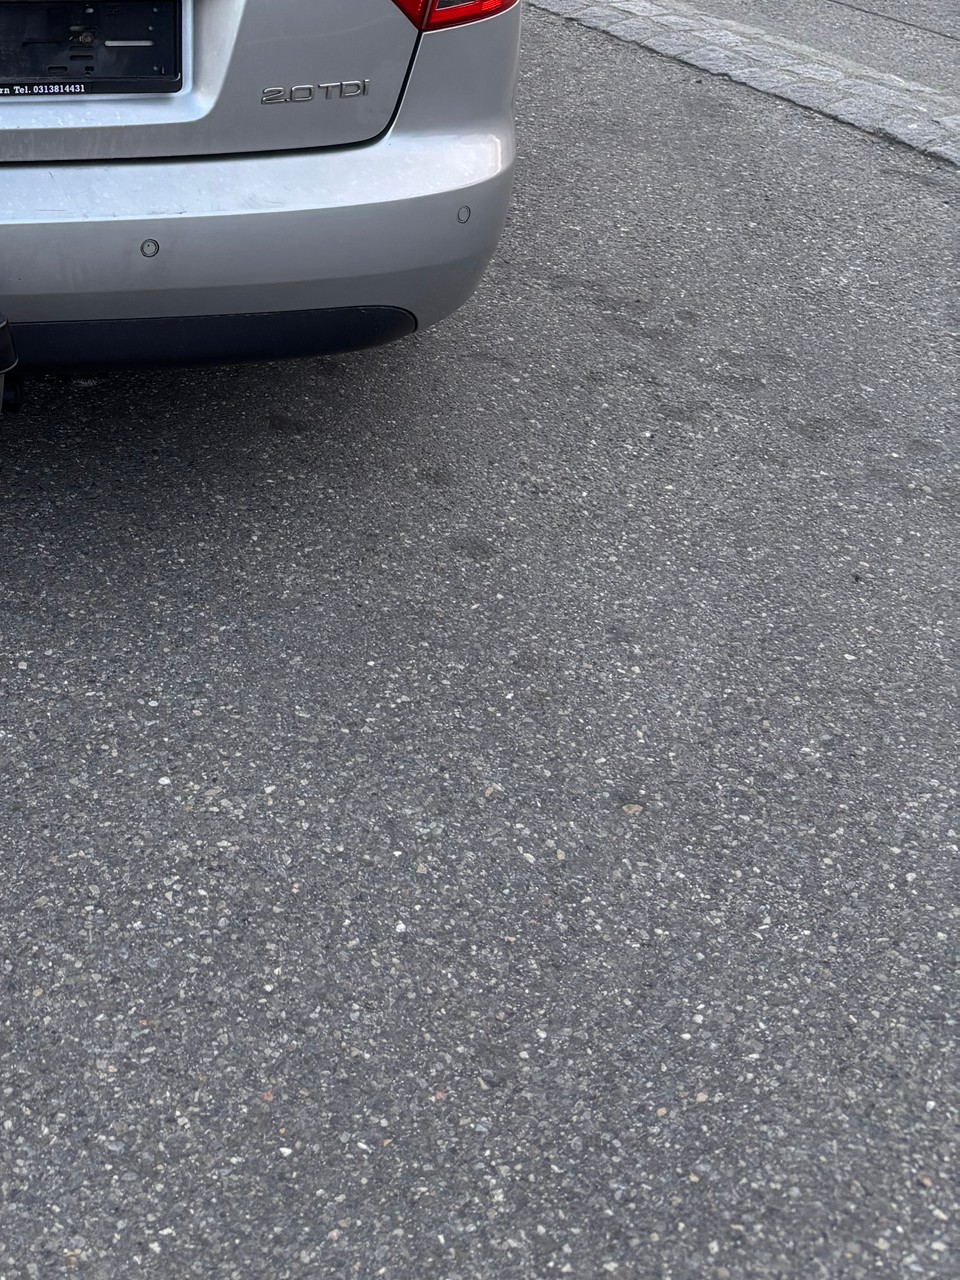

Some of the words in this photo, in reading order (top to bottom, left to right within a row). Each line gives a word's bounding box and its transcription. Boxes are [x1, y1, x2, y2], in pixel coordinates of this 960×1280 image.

[13, 85, 32, 94] Tel.
[33, 84, 86, 93] 0313814431
[261, 84, 315, 105] 2.0
